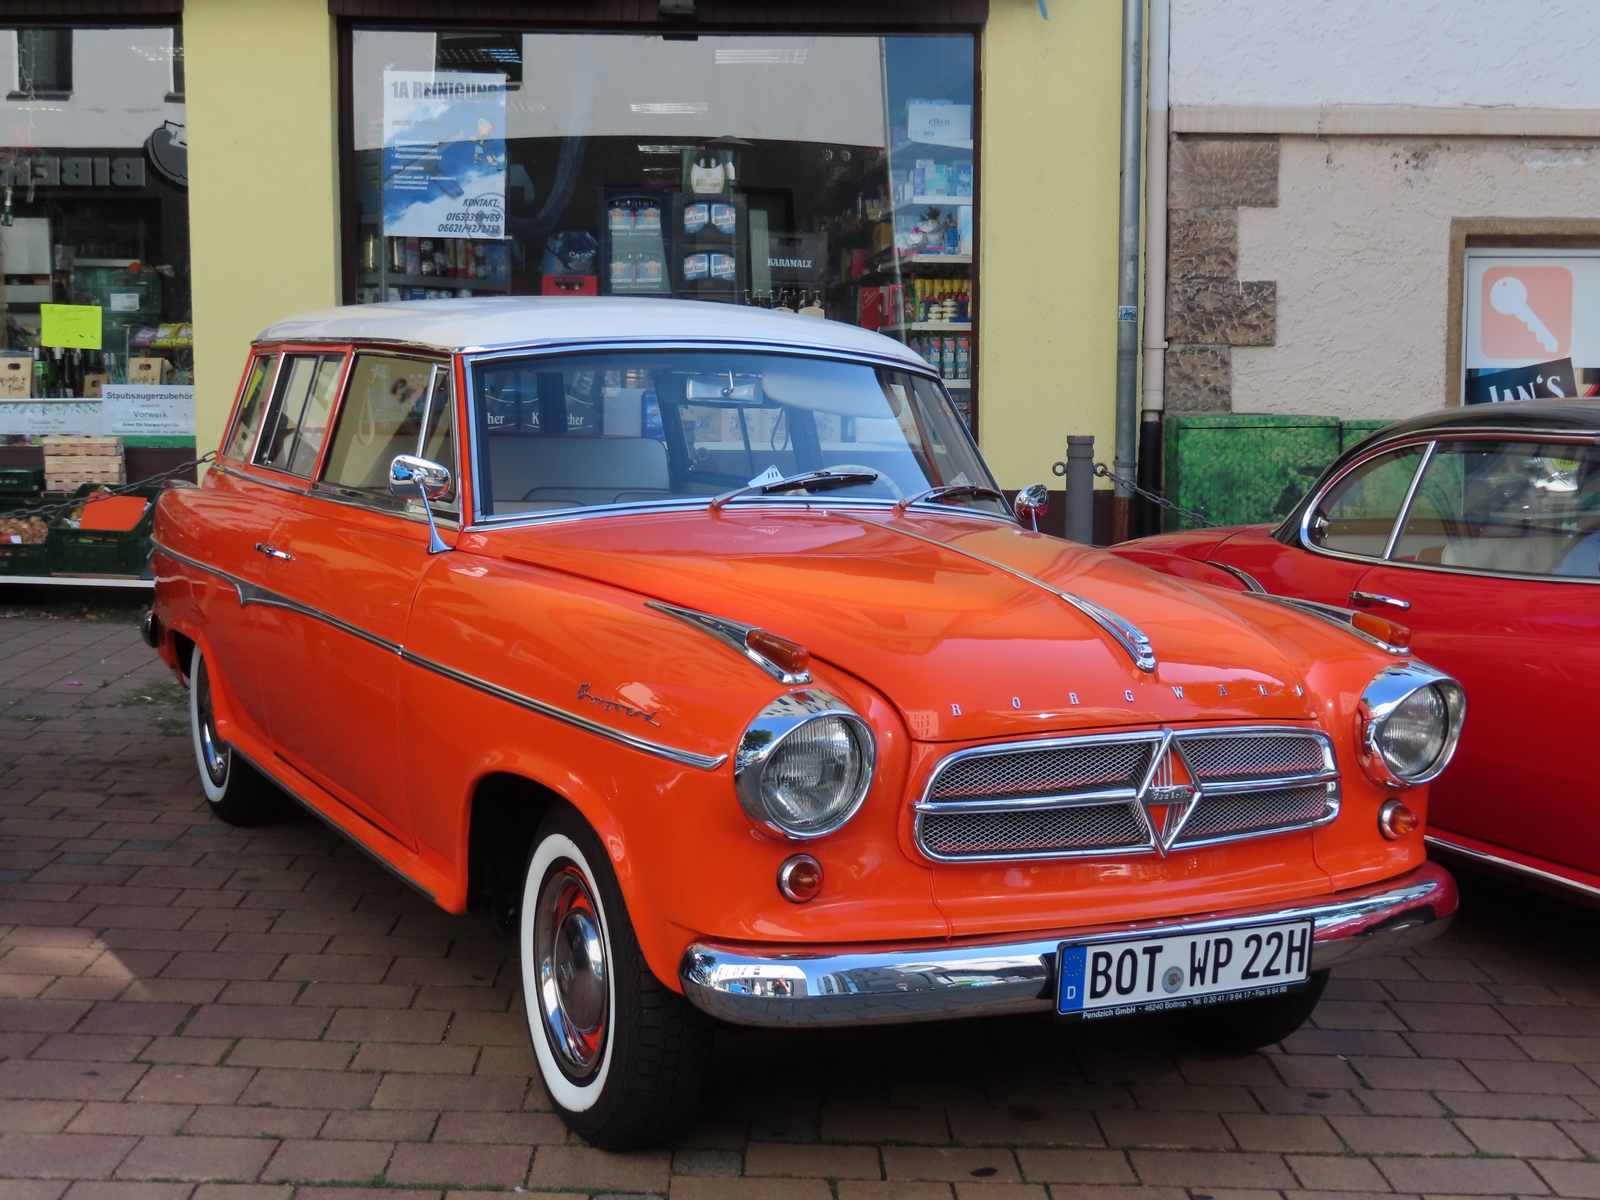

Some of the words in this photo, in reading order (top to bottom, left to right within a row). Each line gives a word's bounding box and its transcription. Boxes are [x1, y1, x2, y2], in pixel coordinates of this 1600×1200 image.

[391, 81, 410, 99] 1A
[463, 198, 500, 208] KONTAKT:
[767, 258, 812, 268] KARAMALZ
[106, 391, 194, 402] Staubsaugerzubehör
[133, 410, 168, 418] Vorwerk
[949, 684, 1305, 717] BORGWARD
[1089, 945, 1164, 999] BOT
[1190, 937, 1233, 987] WP
[1241, 928, 1307, 980] 22H
[1067, 986, 1076, 999] D
[1082, 1008, 1113, 1019] Pendzich
[1115, 1007, 1136, 1016] GmbH
